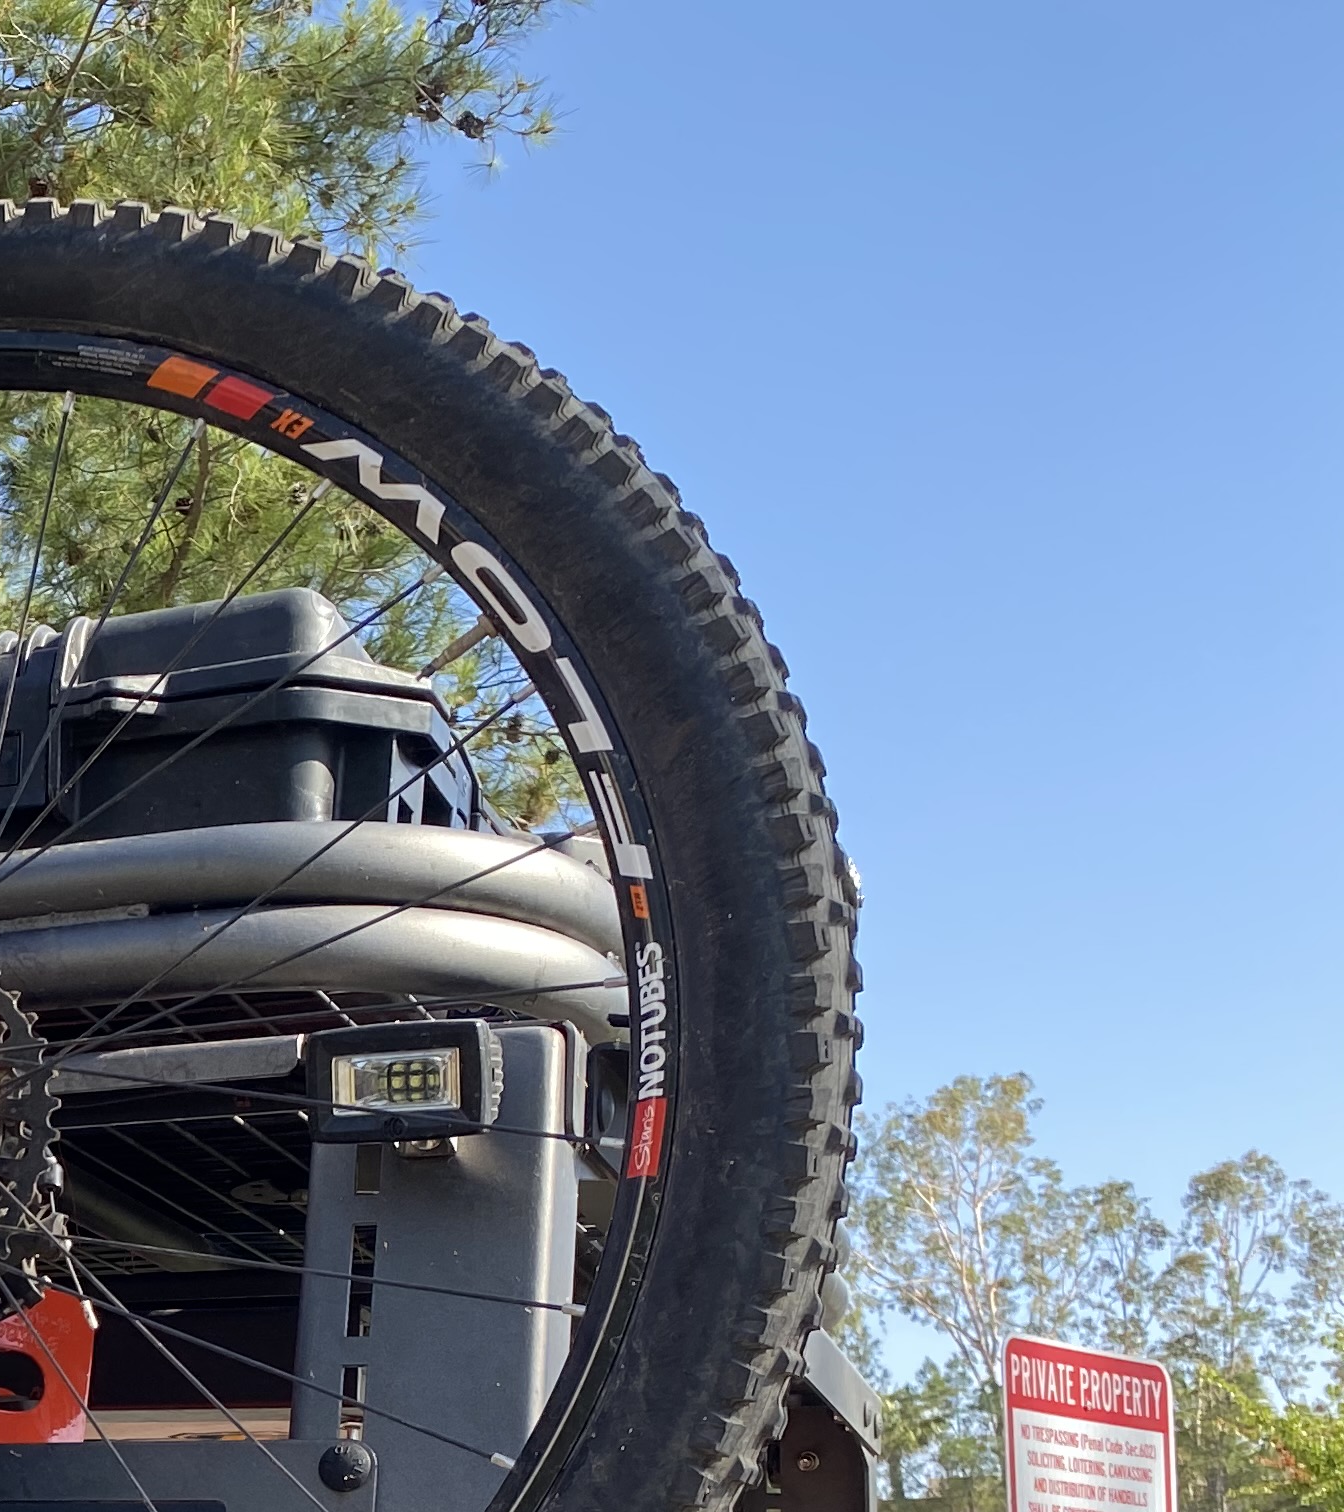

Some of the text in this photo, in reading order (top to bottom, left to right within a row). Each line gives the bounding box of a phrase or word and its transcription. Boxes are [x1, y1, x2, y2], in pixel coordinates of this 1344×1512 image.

[300, 438, 654, 880] FLOW
[637, 940, 666, 1100] NOTUBES
[1010, 1353, 1162, 1420] PRIVATE PROPERTY
[1020, 1424, 1031, 1440] NO
[1032, 1425, 1079, 1449] TRESPASSING
[1080, 1433, 1103, 1451] (Penal
[1105, 1438, 1123, 1455] Code
[1034, 1477, 1148, 1507] AND DISTRIBUTION OF HANDBILLS
[1108, 1463, 1153, 1483] CANVASSING
